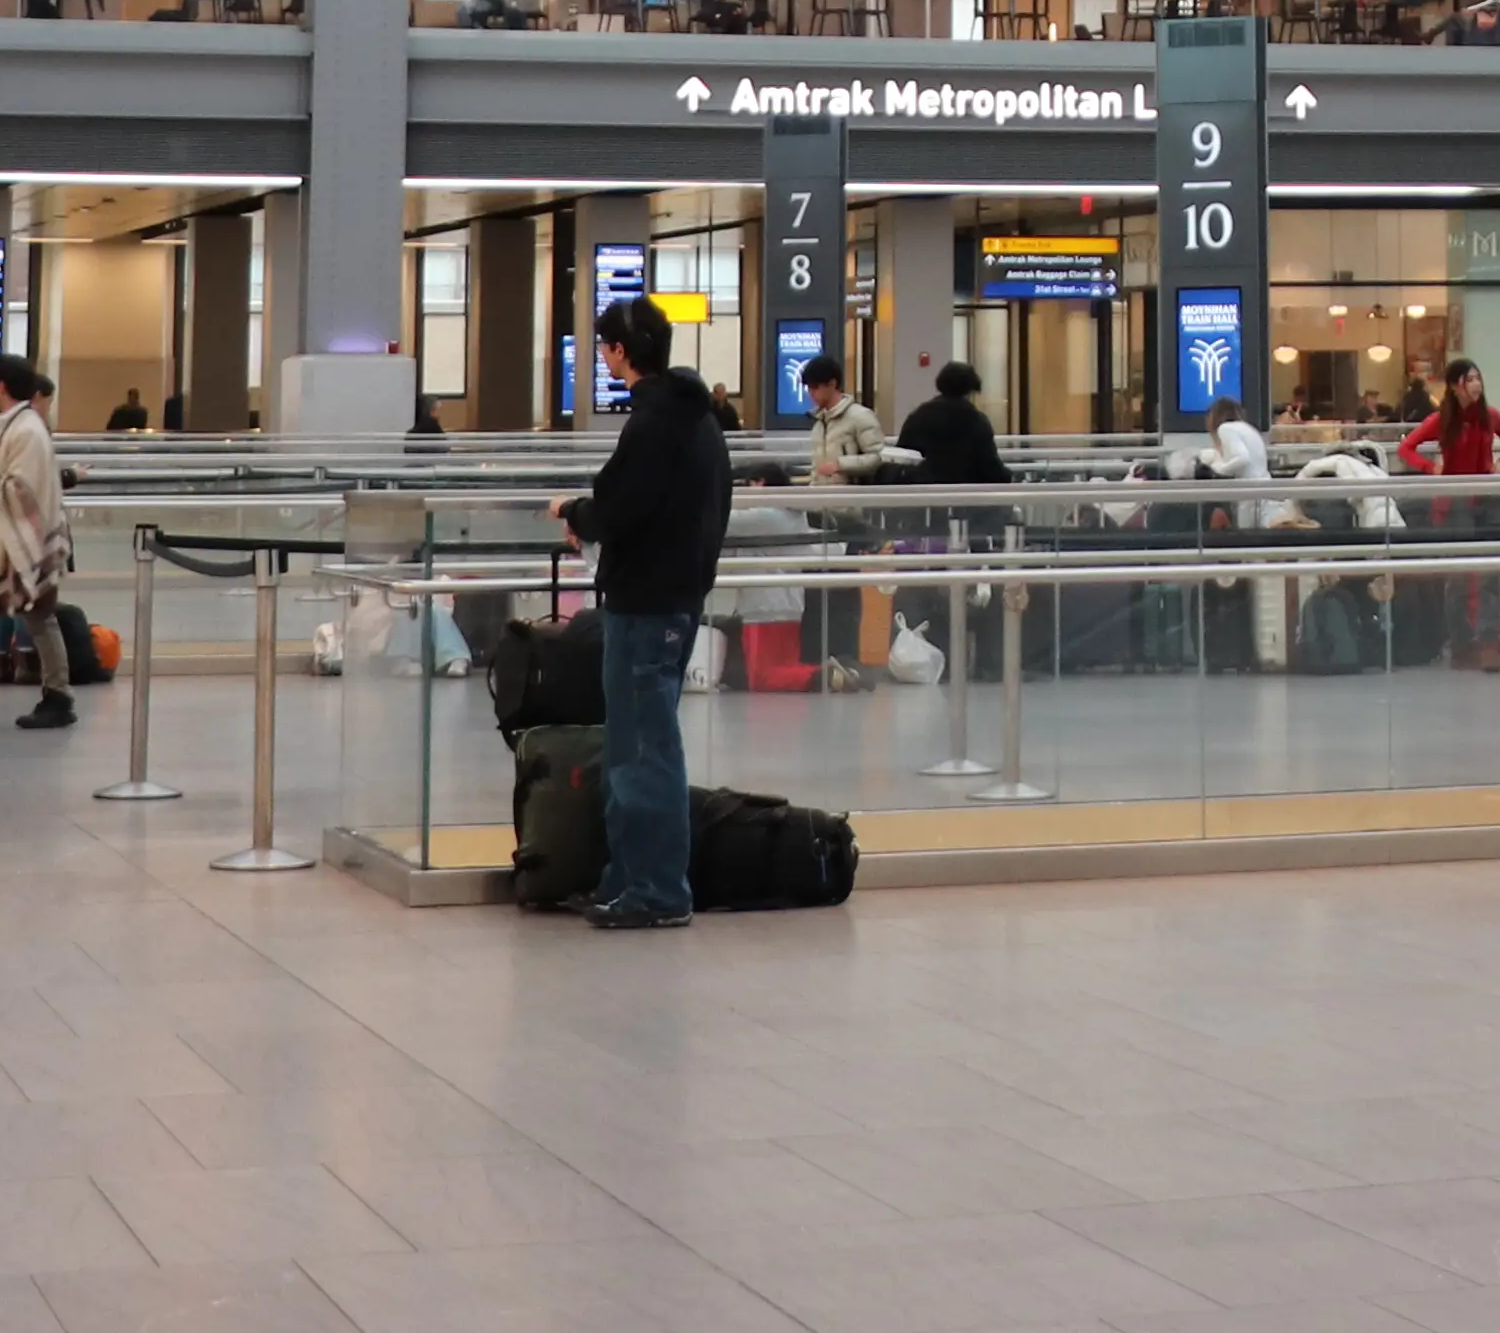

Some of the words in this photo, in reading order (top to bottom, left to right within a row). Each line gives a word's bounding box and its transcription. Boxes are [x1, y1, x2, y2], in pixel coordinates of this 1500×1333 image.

[730, 77, 874, 116] Amtrak
[884, 80, 1123, 126] Metropolitan
[1191, 121, 1222, 167] 9
[790, 192, 812, 228] 7
[1182, 202, 1234, 250] 10
[998, 254, 1026, 264] Amtrak
[1027, 254, 1074, 265] Metropolitan
[789, 254, 812, 290] 8
[1006, 270, 1035, 279] Amtrak
[1052, 284, 1076, 294] Street
[1181, 305, 1237, 315] MOYNIHAN
[1181, 315, 1211, 324] TRAIN
[1213, 314, 1238, 324] HALL
